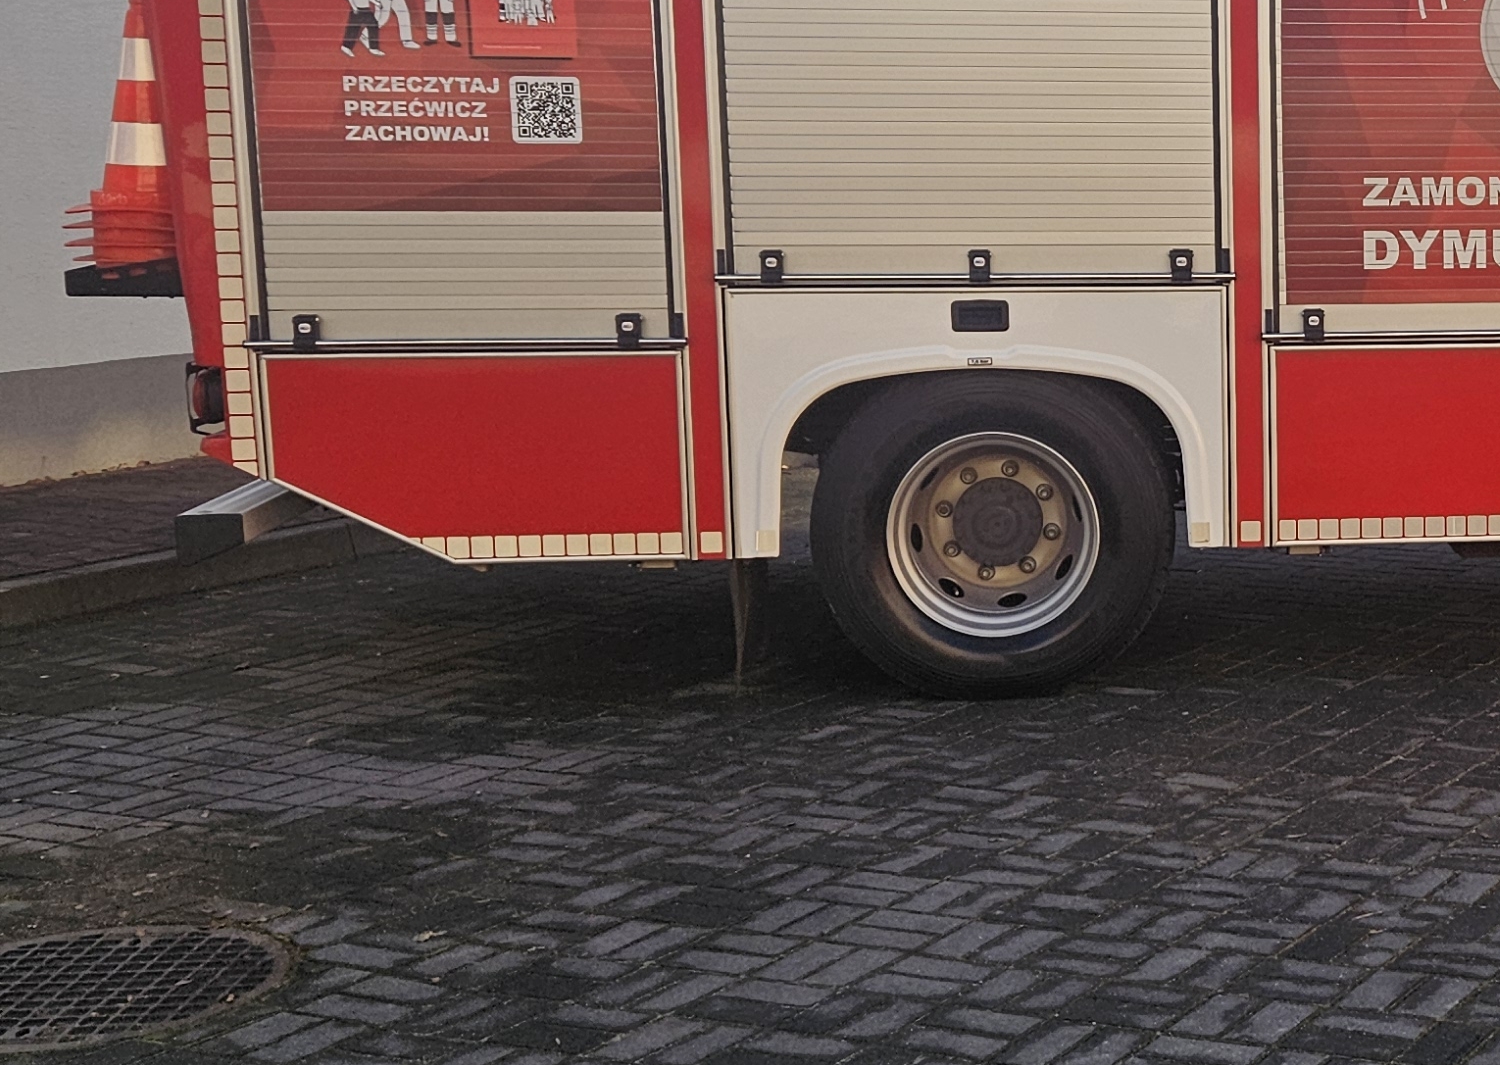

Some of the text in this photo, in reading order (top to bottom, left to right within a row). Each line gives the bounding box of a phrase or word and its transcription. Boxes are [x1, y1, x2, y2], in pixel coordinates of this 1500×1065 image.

[342, 74, 501, 95] PRZECZYTAJ
[344, 96, 488, 118] PRZEĆWICZ
[345, 124, 490, 142] ZACHOWAJ!
